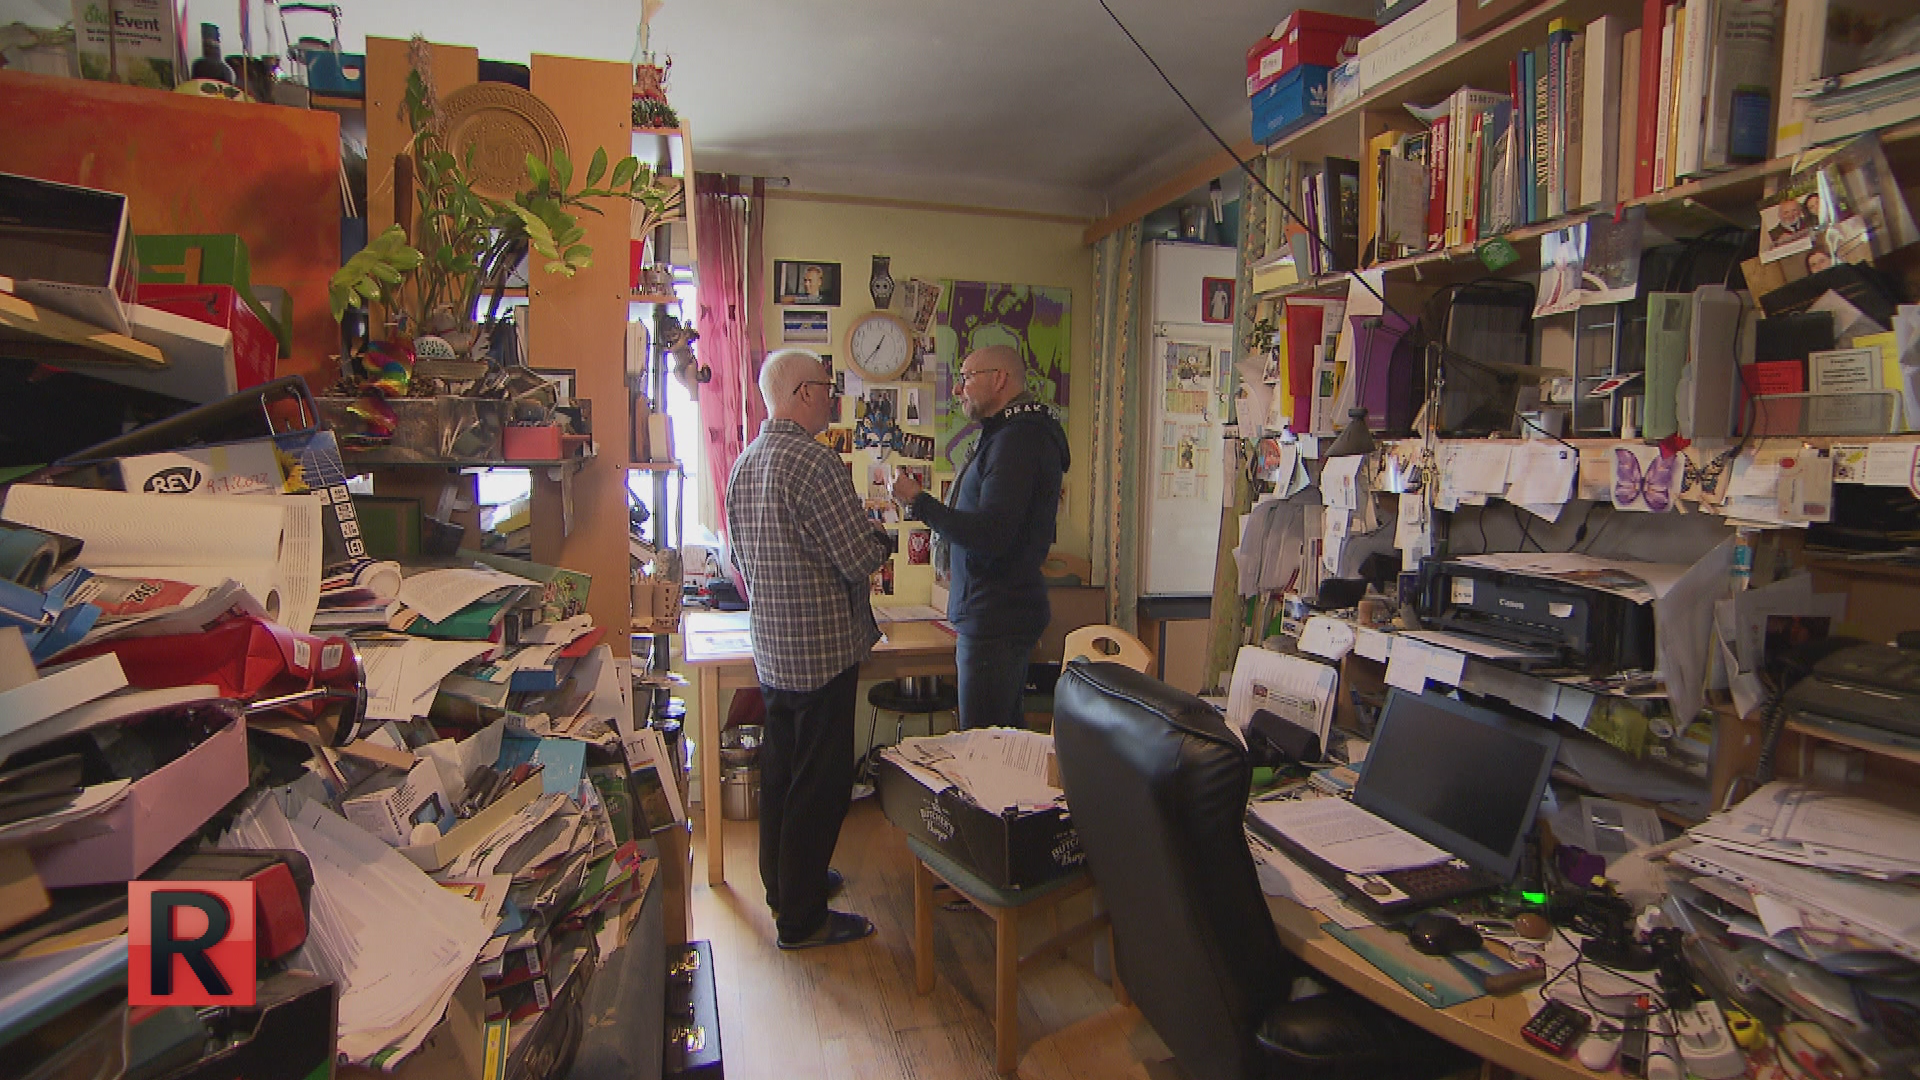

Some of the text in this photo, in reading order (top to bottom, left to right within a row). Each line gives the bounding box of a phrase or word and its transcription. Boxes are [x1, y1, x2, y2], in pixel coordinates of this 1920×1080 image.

[114, 10, 160, 31] Event
[151, 467, 194, 493] REV
[1499, 598, 1525, 611] Canon
